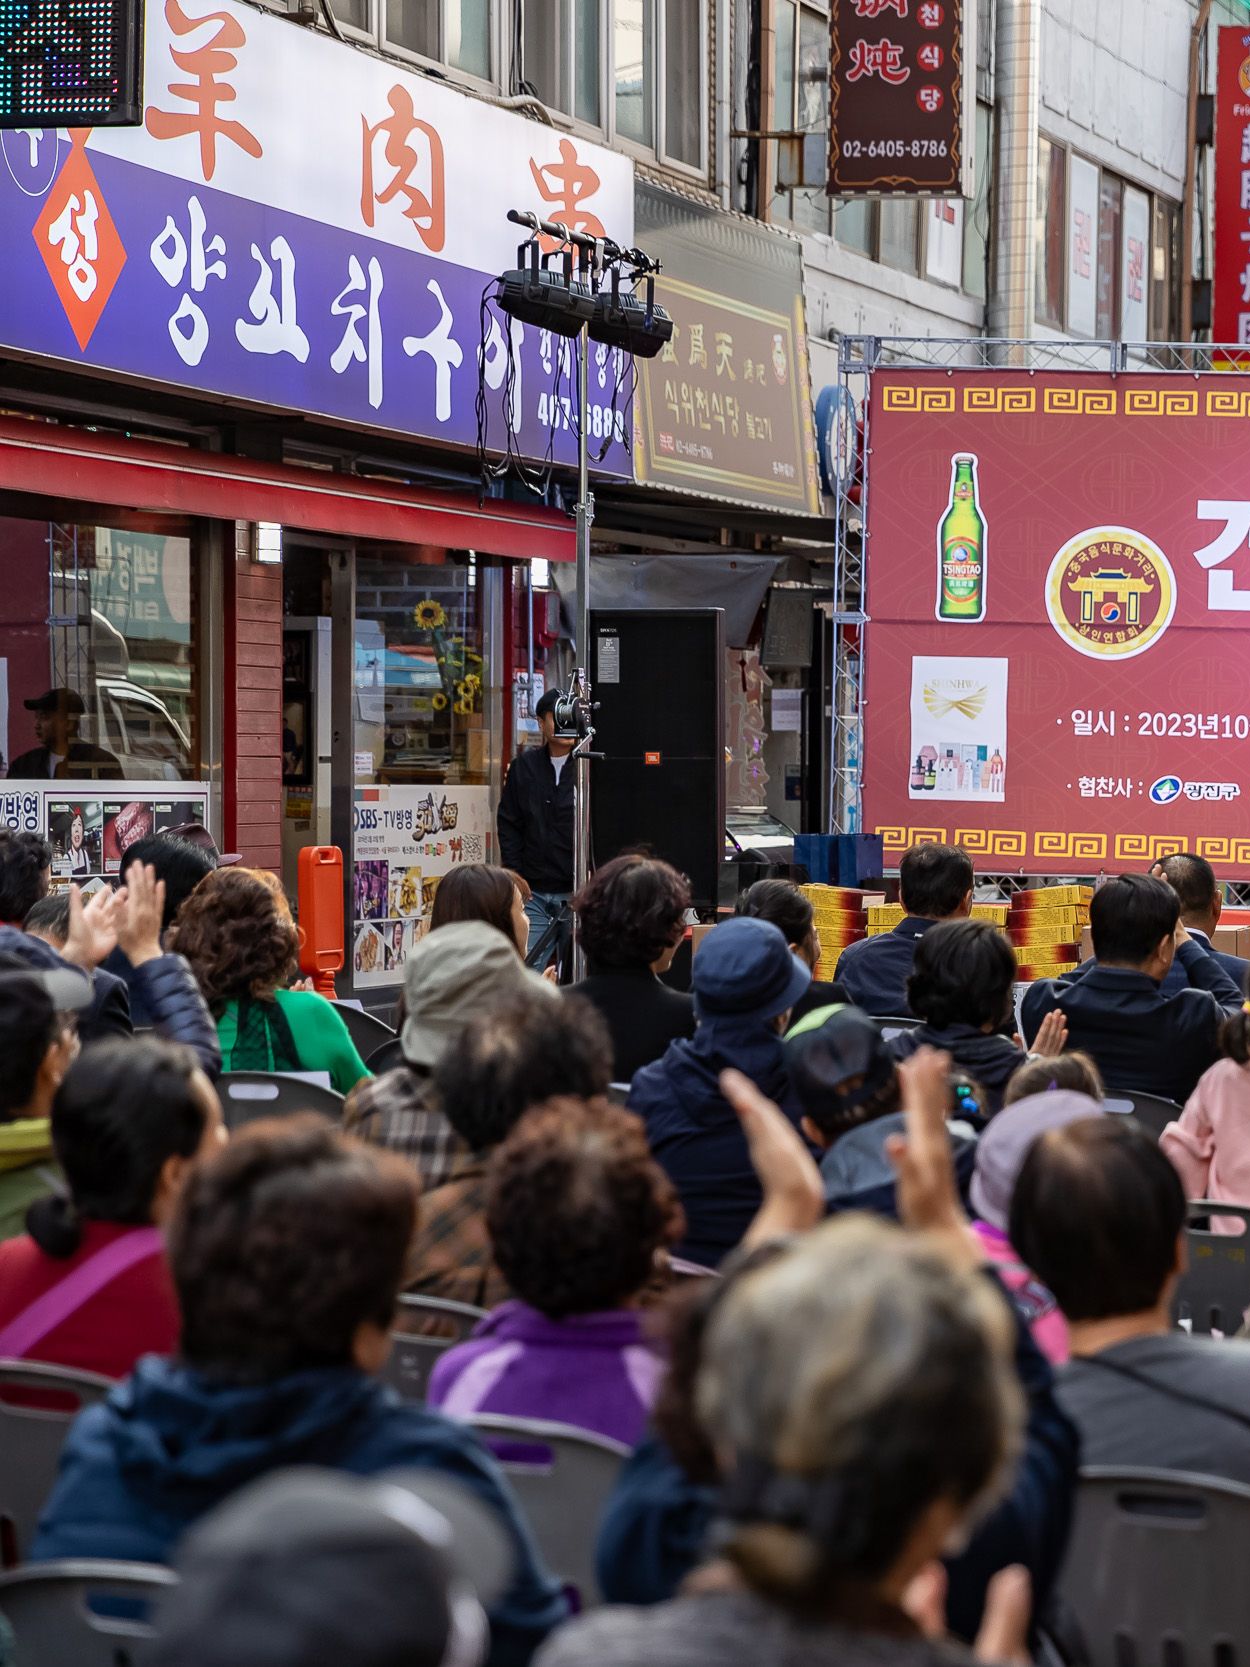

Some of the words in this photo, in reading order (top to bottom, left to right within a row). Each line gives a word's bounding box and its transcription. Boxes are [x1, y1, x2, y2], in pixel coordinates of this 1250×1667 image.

[843, 140, 948, 158] 02-6405-8786
[665, 380, 740, 438] 식위천식당
[943, 564, 981, 575] TSINGTAO
[1069, 542, 1154, 576] 중국음식문화거리
[1079, 624, 1139, 644] 상인연합회
[1071, 710, 1116, 736] 일시
[1078, 776, 1133, 798] 협찬사
[1186, 783, 1239, 799] 광진구
